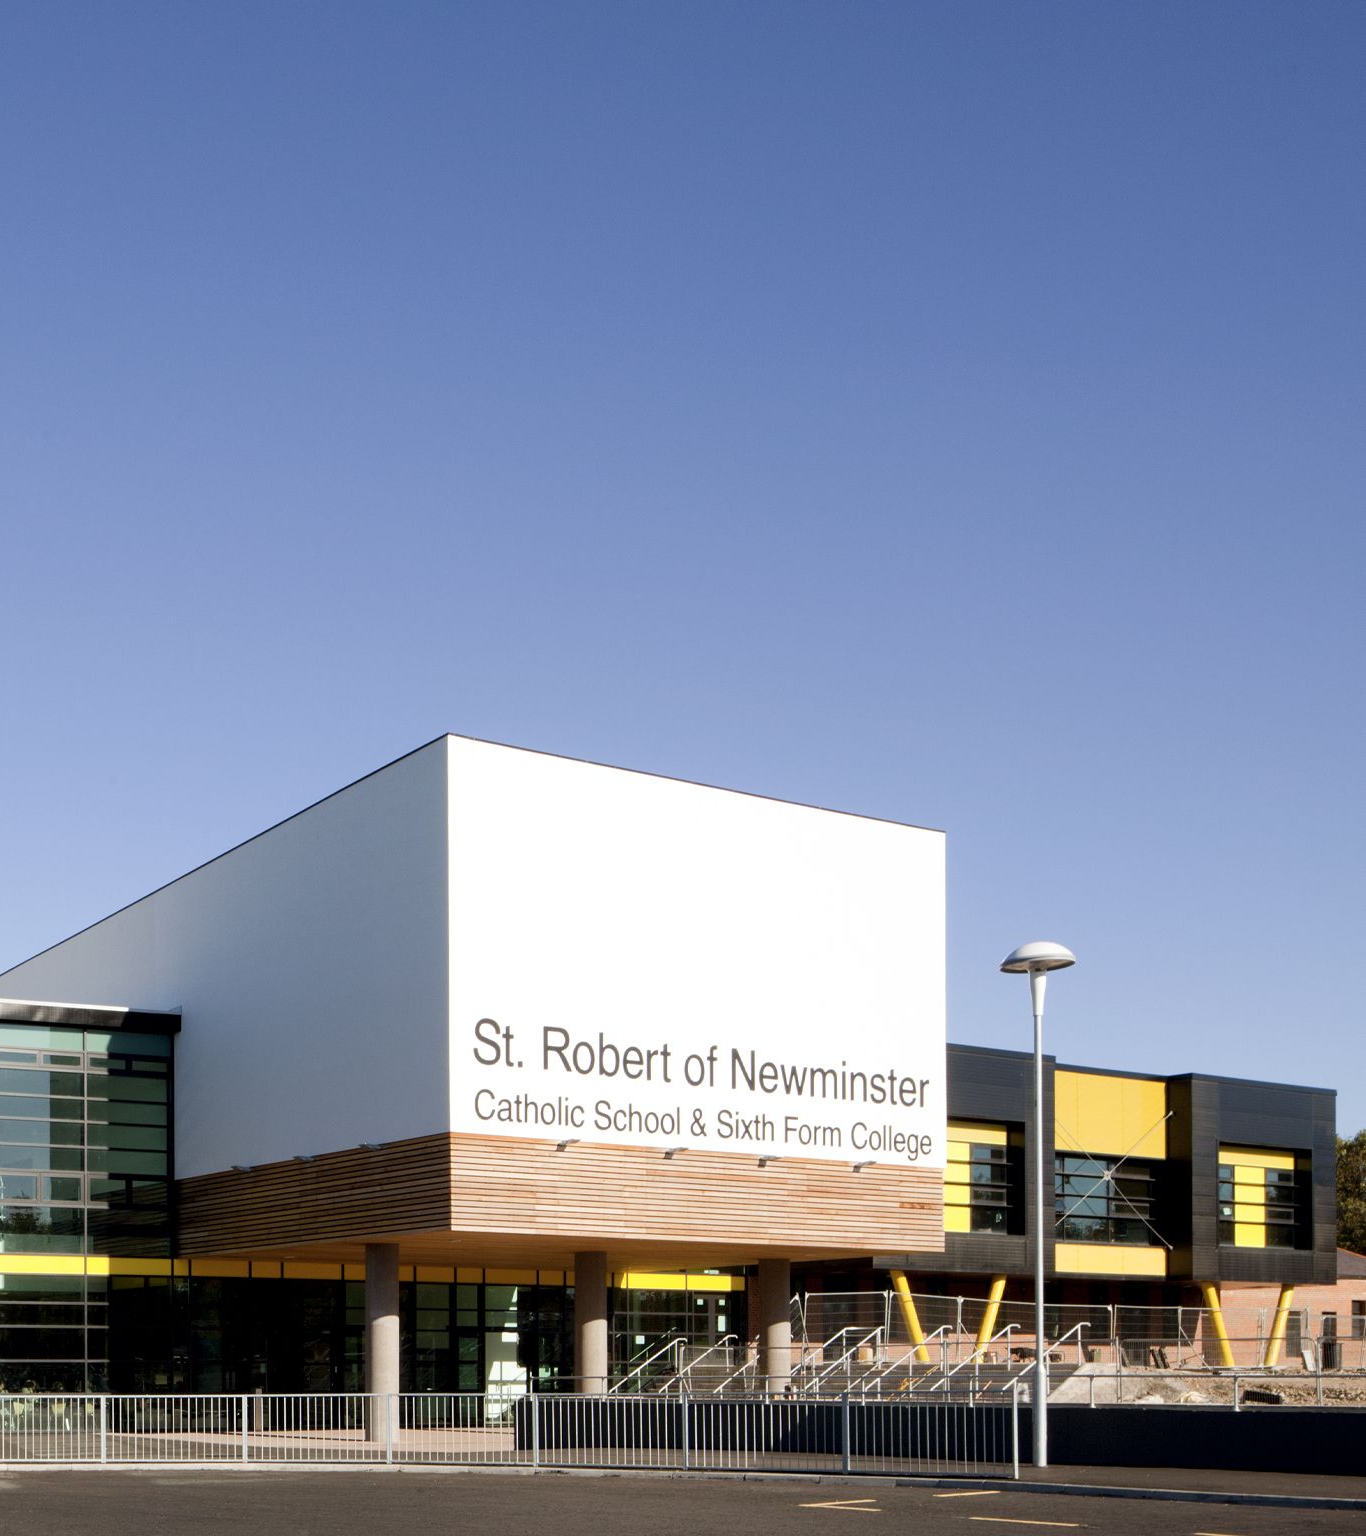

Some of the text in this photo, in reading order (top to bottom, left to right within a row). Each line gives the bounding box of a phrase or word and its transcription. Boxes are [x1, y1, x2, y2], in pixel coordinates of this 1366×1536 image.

[473, 1018, 930, 1108] St. Robert of Newminster
[474, 1088, 932, 1162] Catholic School & Sixth Form College
